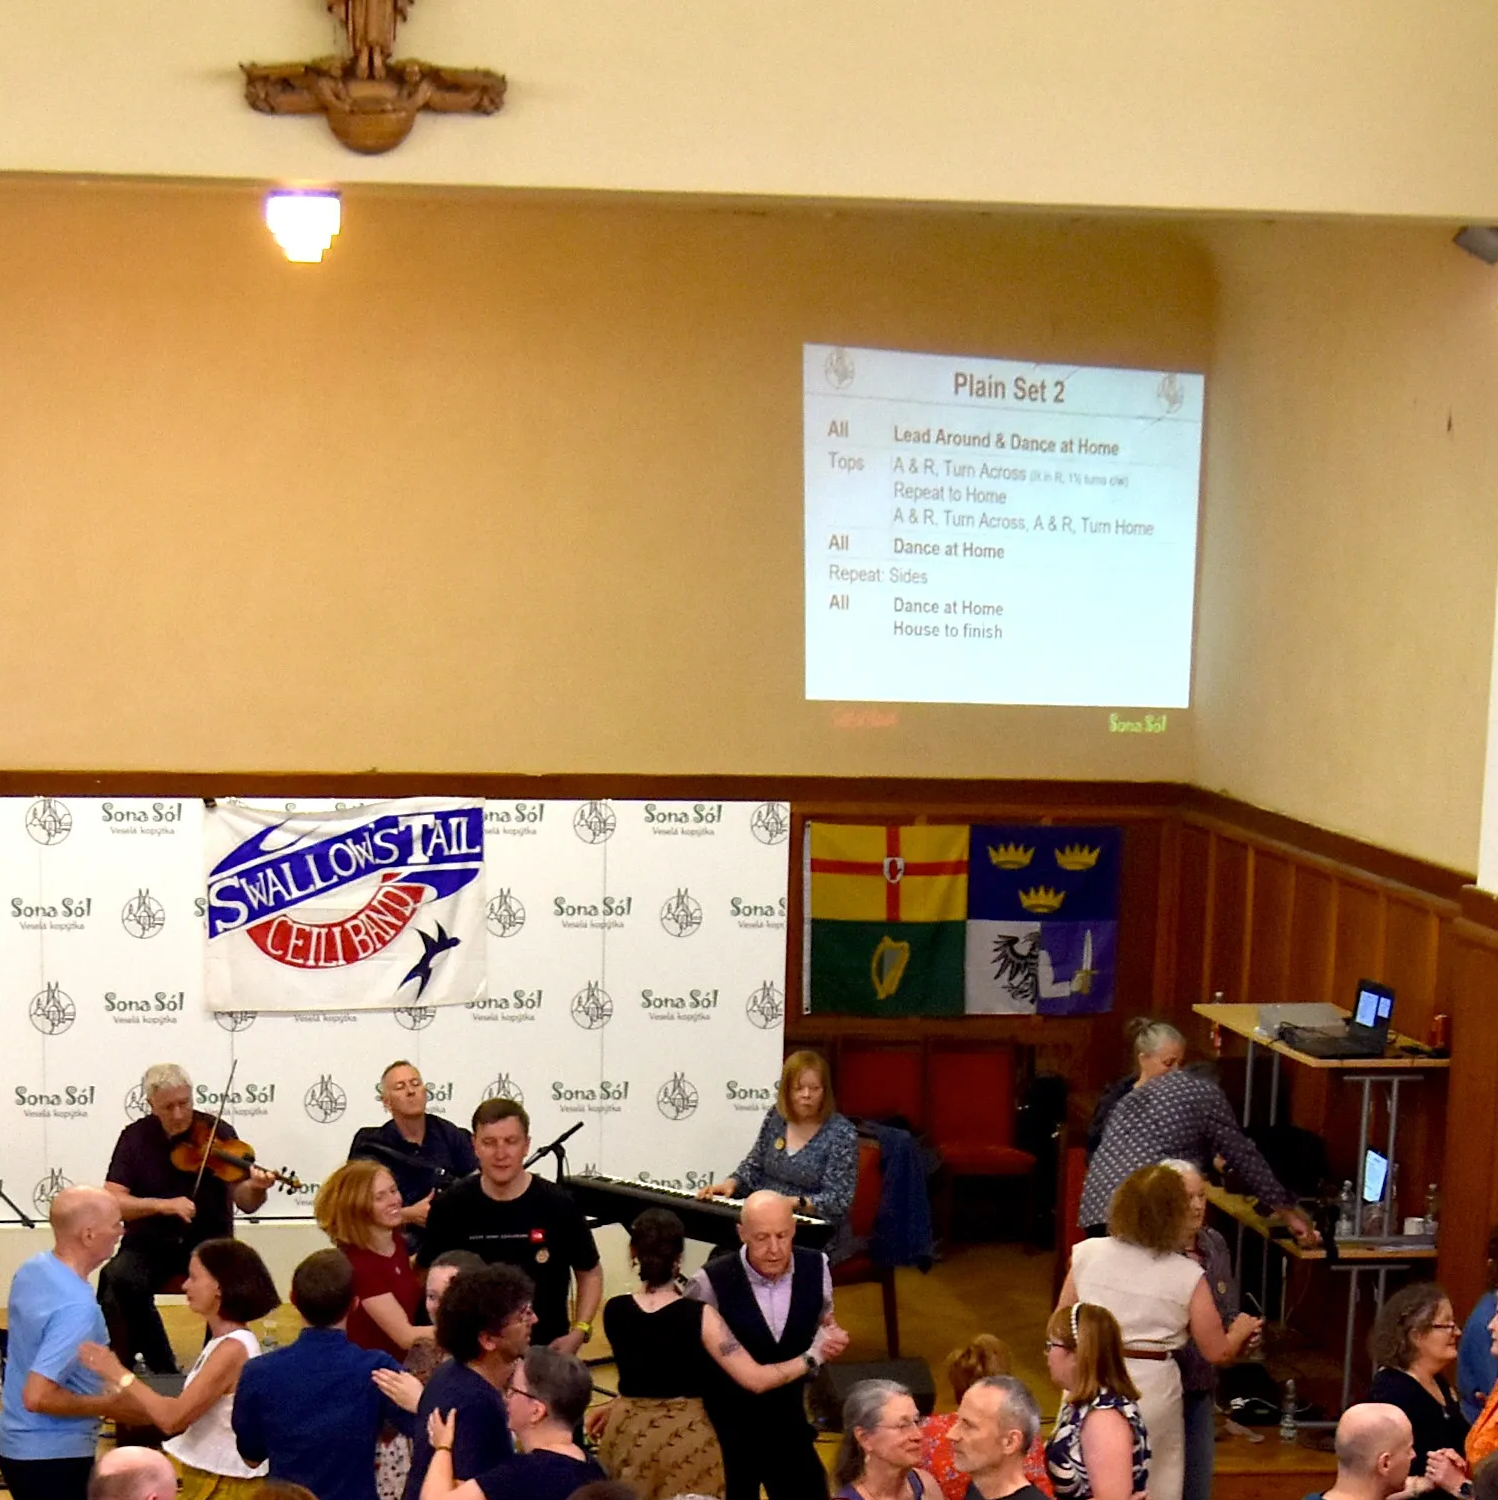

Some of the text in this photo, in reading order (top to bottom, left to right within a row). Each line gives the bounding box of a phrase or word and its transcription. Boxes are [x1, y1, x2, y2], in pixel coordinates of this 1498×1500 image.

[954, 372, 1064, 403] Plain Set 2
[828, 421, 848, 437] All
[894, 427, 1119, 455] Lead Around & Dance at Home
[829, 452, 864, 471] Tops
[894, 457, 904, 472] A
[909, 459, 918, 473] &
[945, 461, 975, 477] Turn
[980, 464, 1026, 481] Across
[894, 483, 1006, 504] Repeat to Home
[894, 510, 903, 524] A
[909, 510, 918, 524] &
[944, 511, 975, 528] Turn
[979, 513, 1029, 533] Across,
[1034, 516, 1044, 530] A
[1048, 516, 1057, 530] &
[1061, 517, 1076, 534] R,
[1081, 518, 1110, 534] Turn
[1115, 520, 1154, 536] Home
[829, 535, 849, 551] All
[894, 538, 1004, 559] Dance at Home
[890, 568, 927, 584] Sides
[830, 595, 849, 610] All
[894, 598, 1003, 616] Dance at Home
[894, 622, 1003, 639] House to finish
[102, 803, 182, 822] Sona Sól
[484, 803, 545, 823] na Sól
[645, 804, 722, 823] Sona Sól
[398, 814, 482, 864] TAIL
[11, 898, 91, 917] Sona Sól
[554, 897, 632, 916] Sona Sól
[730, 897, 775, 917] Sona
[265, 886, 419, 967] CEILI BAND
[105, 992, 184, 1012] Sona Sól
[513, 990, 542, 1010] Sól
[642, 989, 718, 1008] Sona Sól
[15, 1086, 94, 1106] Sona Sól
[196, 1084, 275, 1104] Sona Sól
[552, 1081, 629, 1100] Sona Sól
[726, 1081, 771, 1100] Sona
[686, 1171, 715, 1190] Sól
